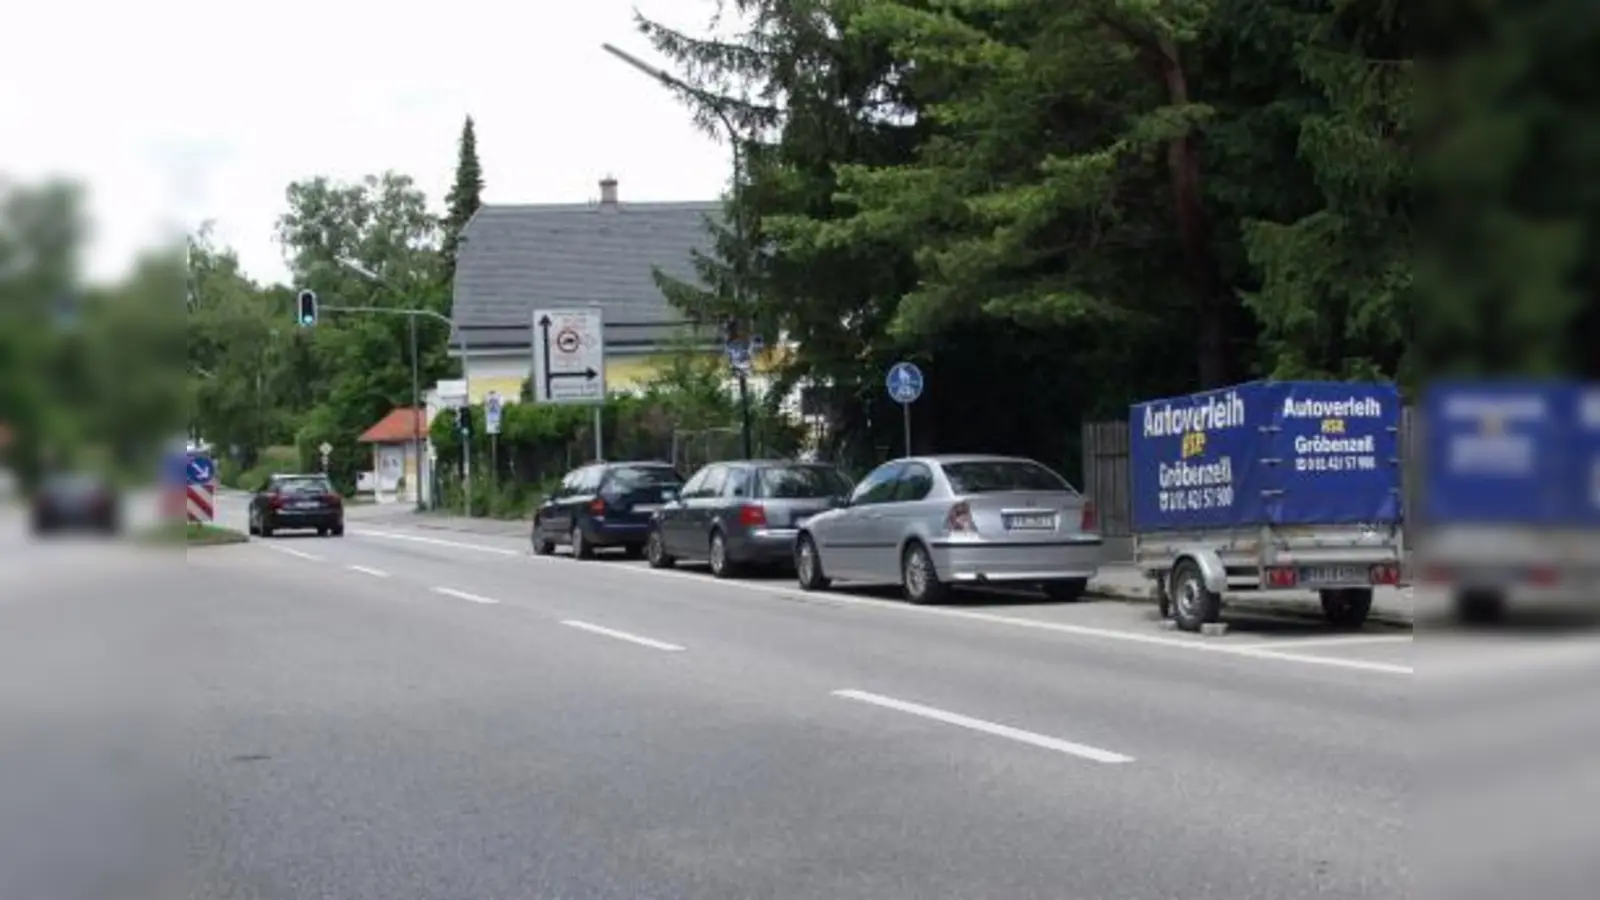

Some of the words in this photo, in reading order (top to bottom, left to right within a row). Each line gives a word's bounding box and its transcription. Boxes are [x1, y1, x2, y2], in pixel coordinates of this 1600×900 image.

[1143, 391, 1245, 438] Autoverleih
[1283, 397, 1381, 417] Autoverleih
[1295, 435, 1375, 454] Gröbenzell
[1160, 456, 1232, 488] Gröbenzell
